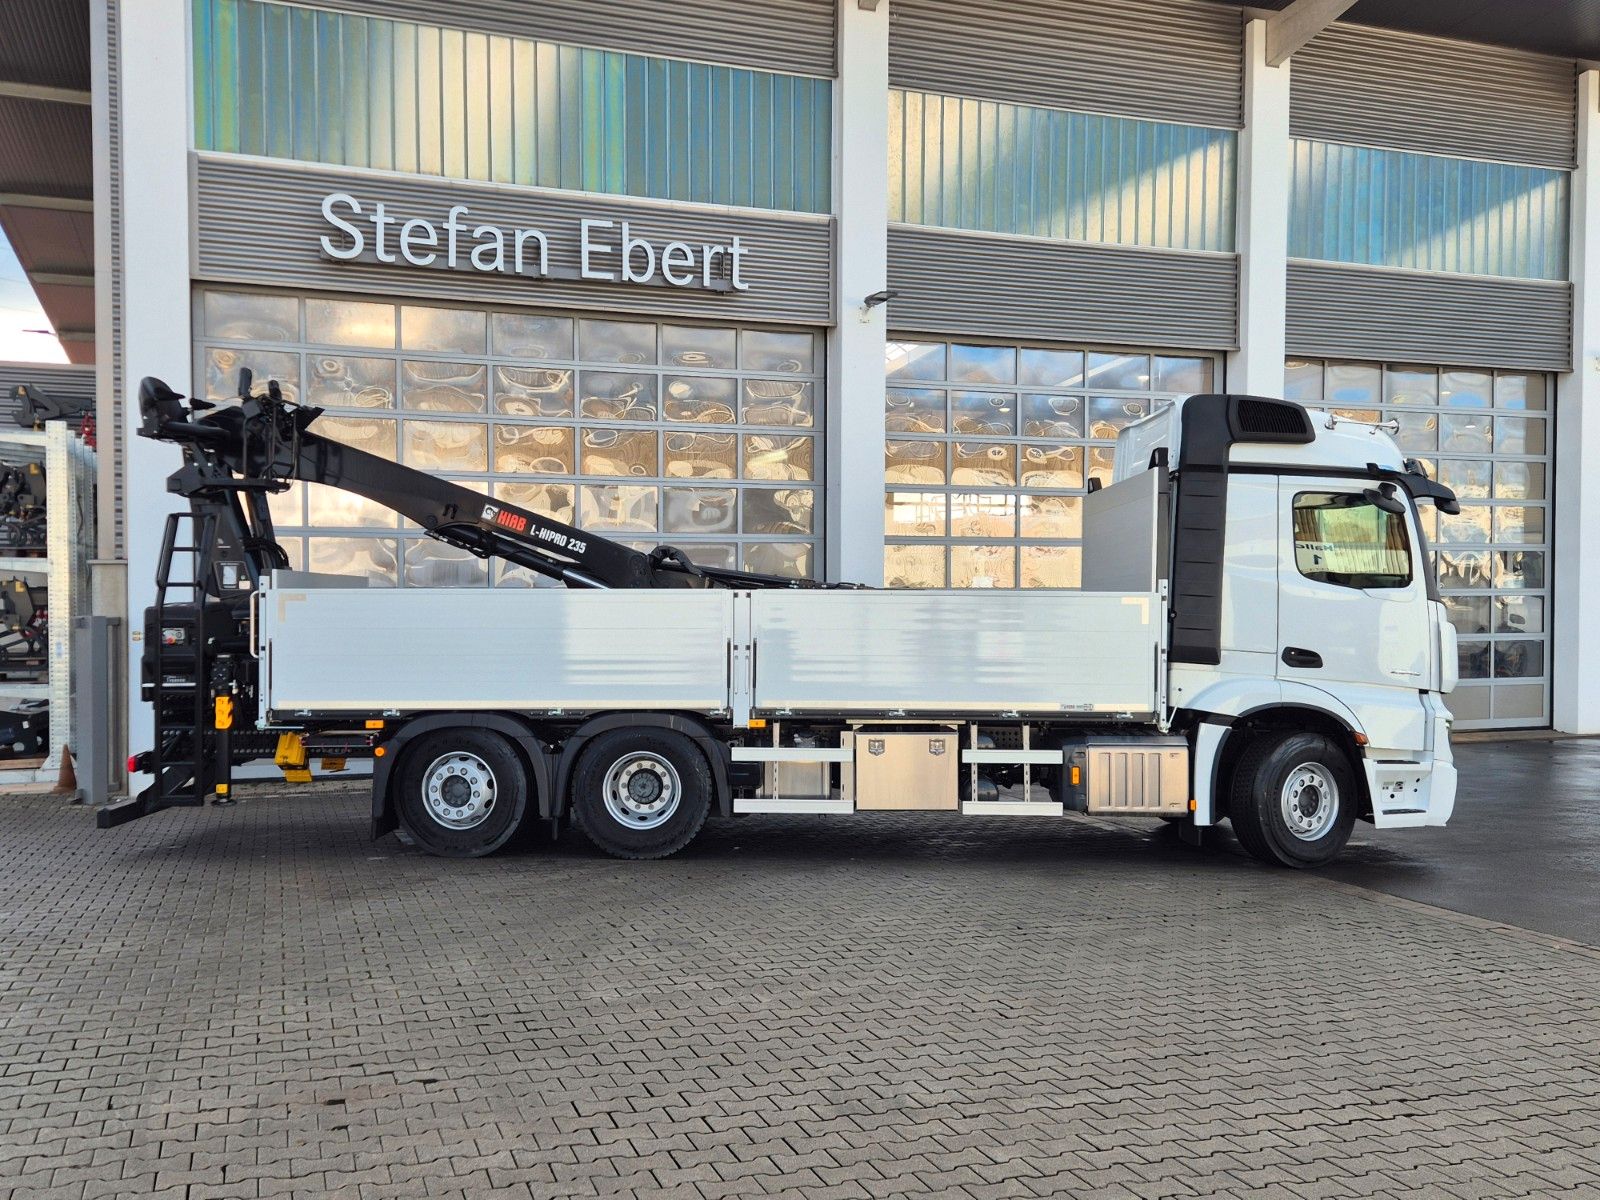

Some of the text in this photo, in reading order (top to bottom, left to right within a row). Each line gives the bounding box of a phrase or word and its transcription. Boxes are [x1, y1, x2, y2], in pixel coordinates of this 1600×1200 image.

[319, 193, 749, 290] Stefan Ebert
[497, 510, 528, 532] HIAB
[530, 524, 587, 554] L-HIPRO 235
